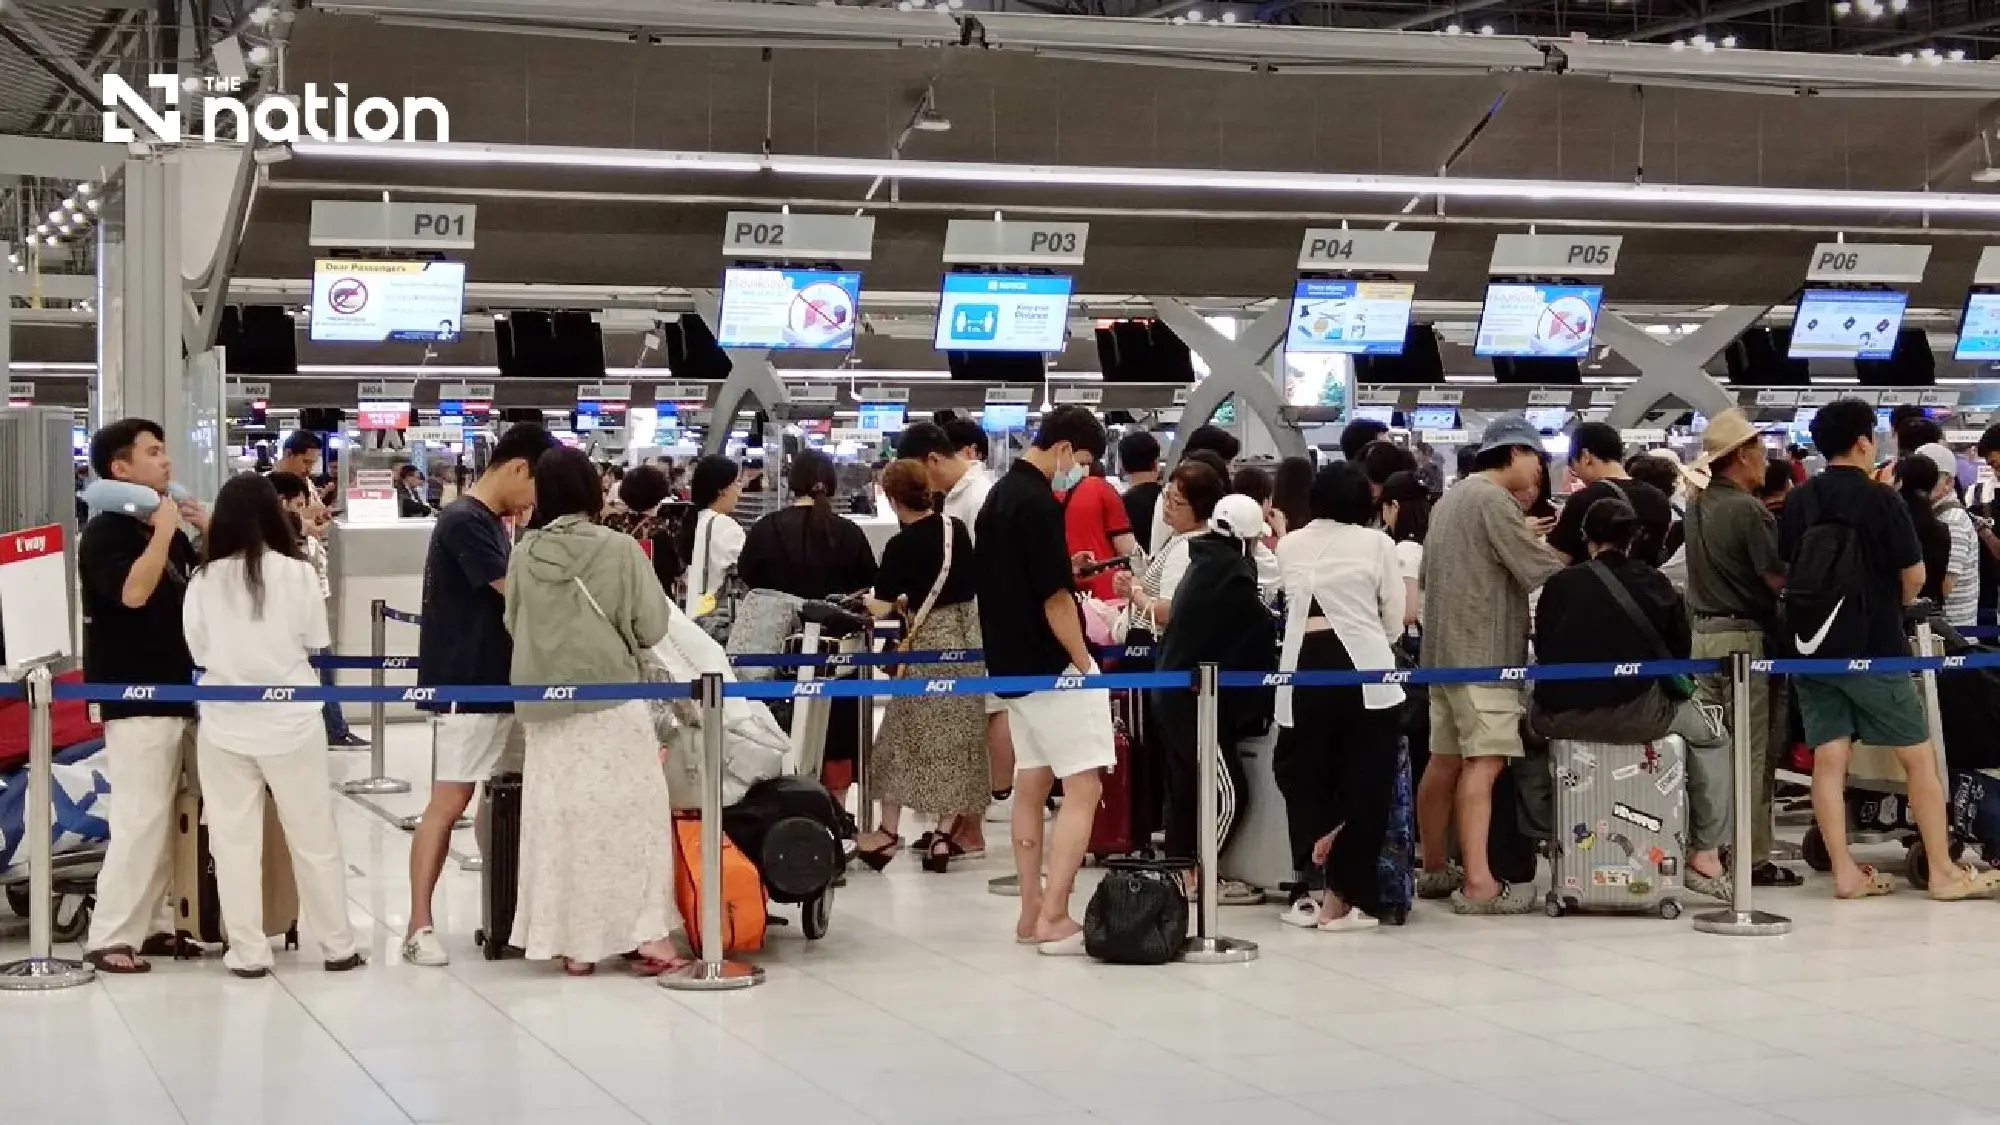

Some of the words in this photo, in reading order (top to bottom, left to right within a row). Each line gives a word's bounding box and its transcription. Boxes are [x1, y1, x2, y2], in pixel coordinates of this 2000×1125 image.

[414, 213, 465, 236] P01
[734, 223, 784, 244] P02
[1030, 232, 1076, 253] P03
[1309, 239, 1353, 260] P04
[1567, 245, 1610, 264] P05
[1817, 252, 1859, 271] P06
[1749, 660, 1775, 673] AOT
[1848, 659, 1872, 671] AOT
[1943, 655, 1966, 667] AOT
[1499, 667, 1527, 680] AOT
[1614, 662, 1642, 675] AOT
[1055, 677, 1086, 689] AOT
[1262, 674, 1293, 686] AOT
[1382, 671, 1411, 684] AOT
[792, 682, 825, 695] AOT
[925, 679, 956, 692] AOT
[122, 686, 156, 700] AOT
[262, 687, 296, 701] AOT
[402, 687, 436, 701] AOT
[543, 686, 577, 700] AOT
